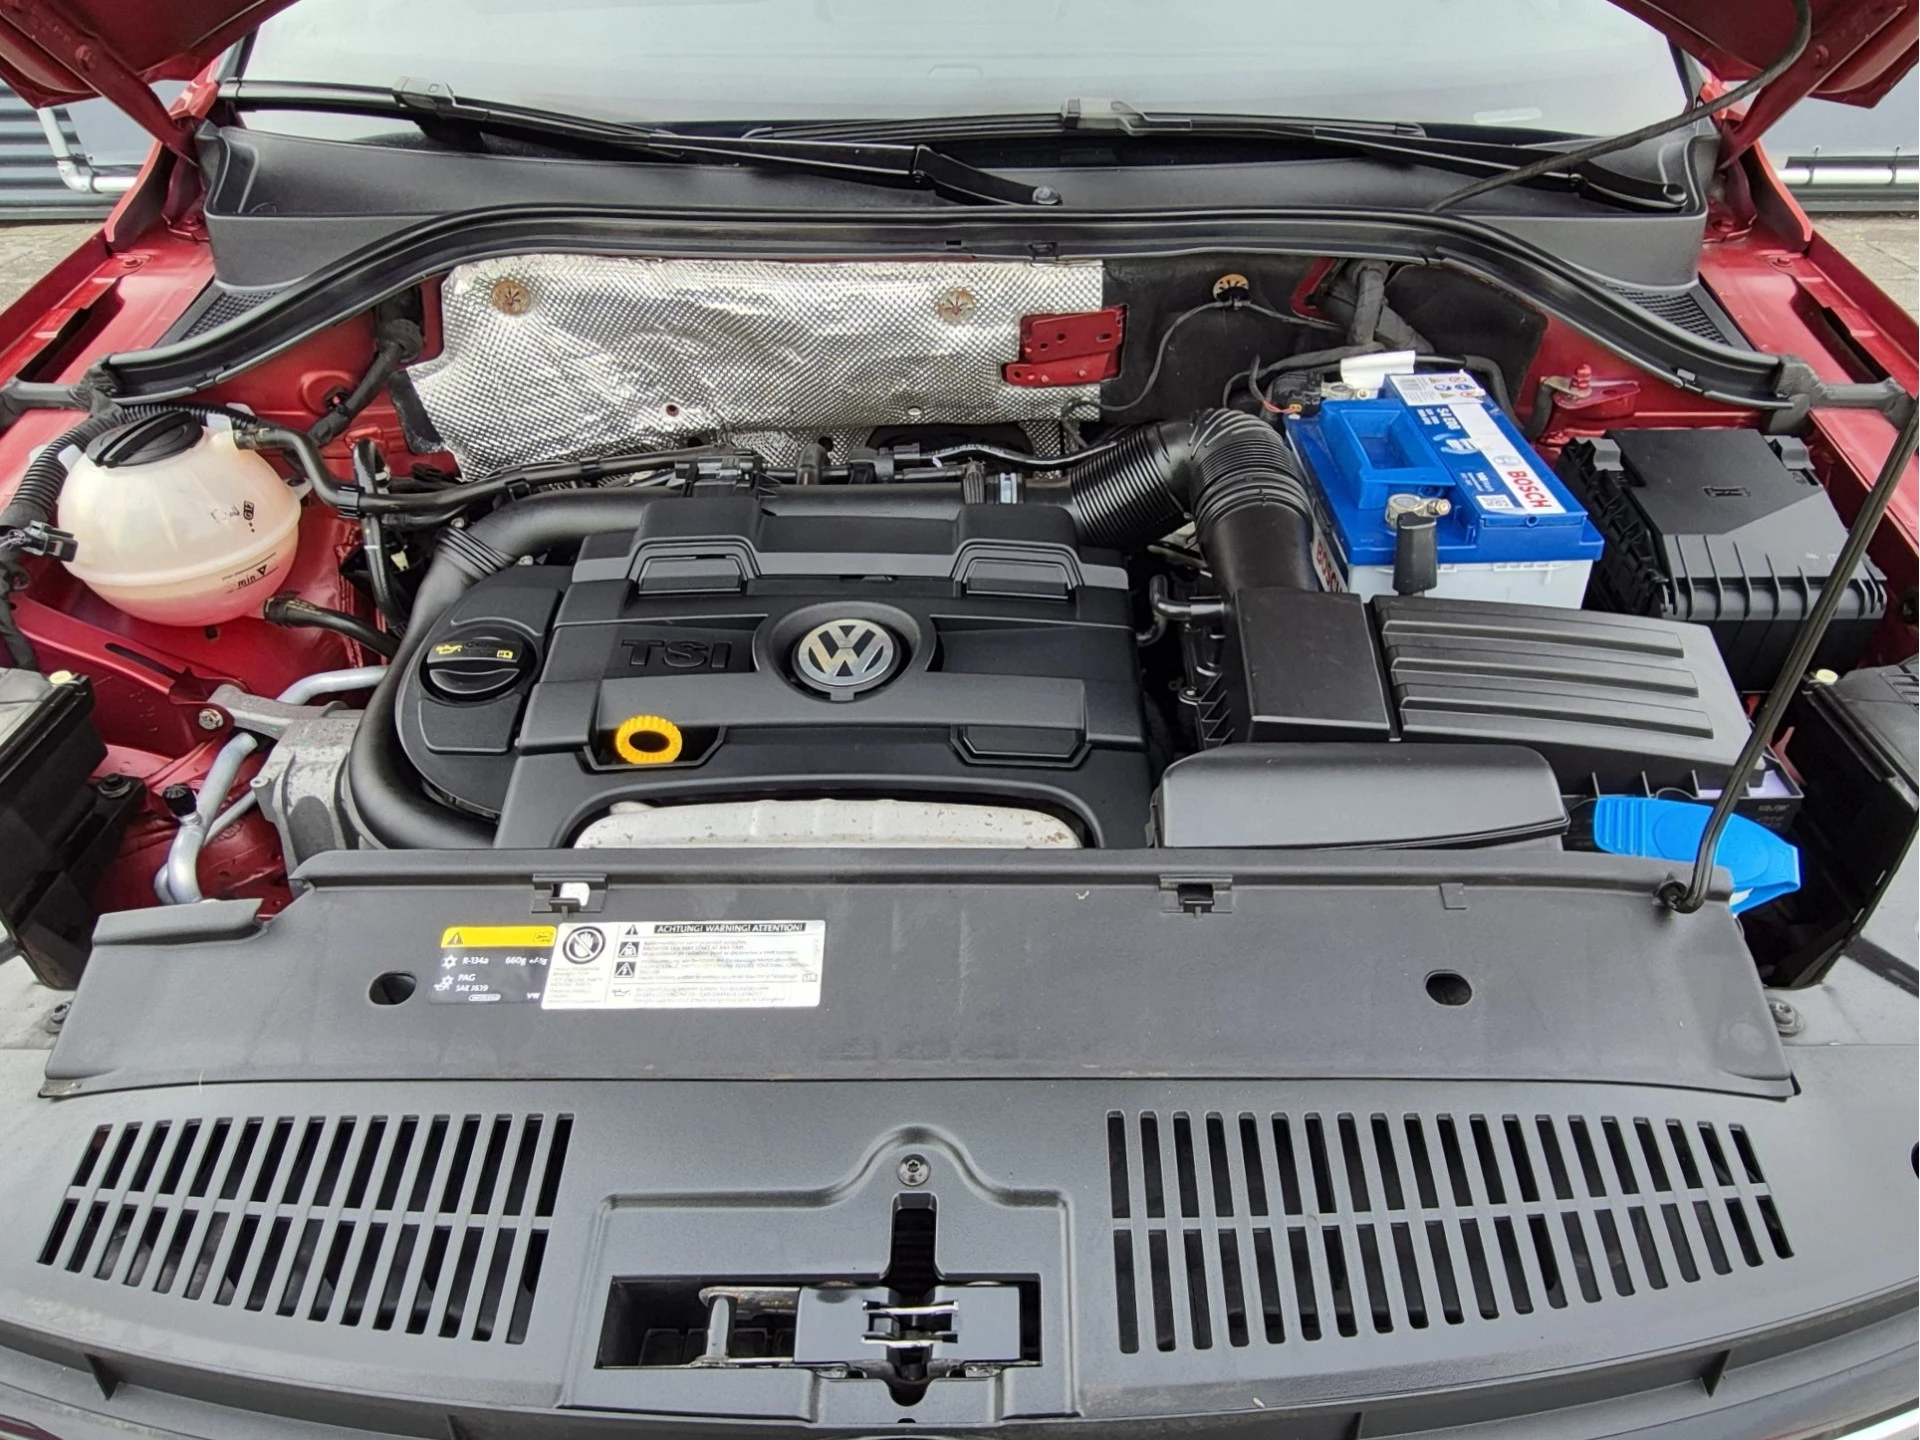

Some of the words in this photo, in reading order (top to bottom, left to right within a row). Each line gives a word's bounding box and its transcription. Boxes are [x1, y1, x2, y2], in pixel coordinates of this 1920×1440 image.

[1506, 470, 1553, 508] BOSCH
[237, 574, 257, 588] min
[620, 638, 733, 669] TSI
[657, 924, 703, 933] ACHTUNG!
[705, 924, 751, 932] WARNING!
[751, 923, 804, 932] ATTENTION!
[457, 973, 477, 982] PAG
